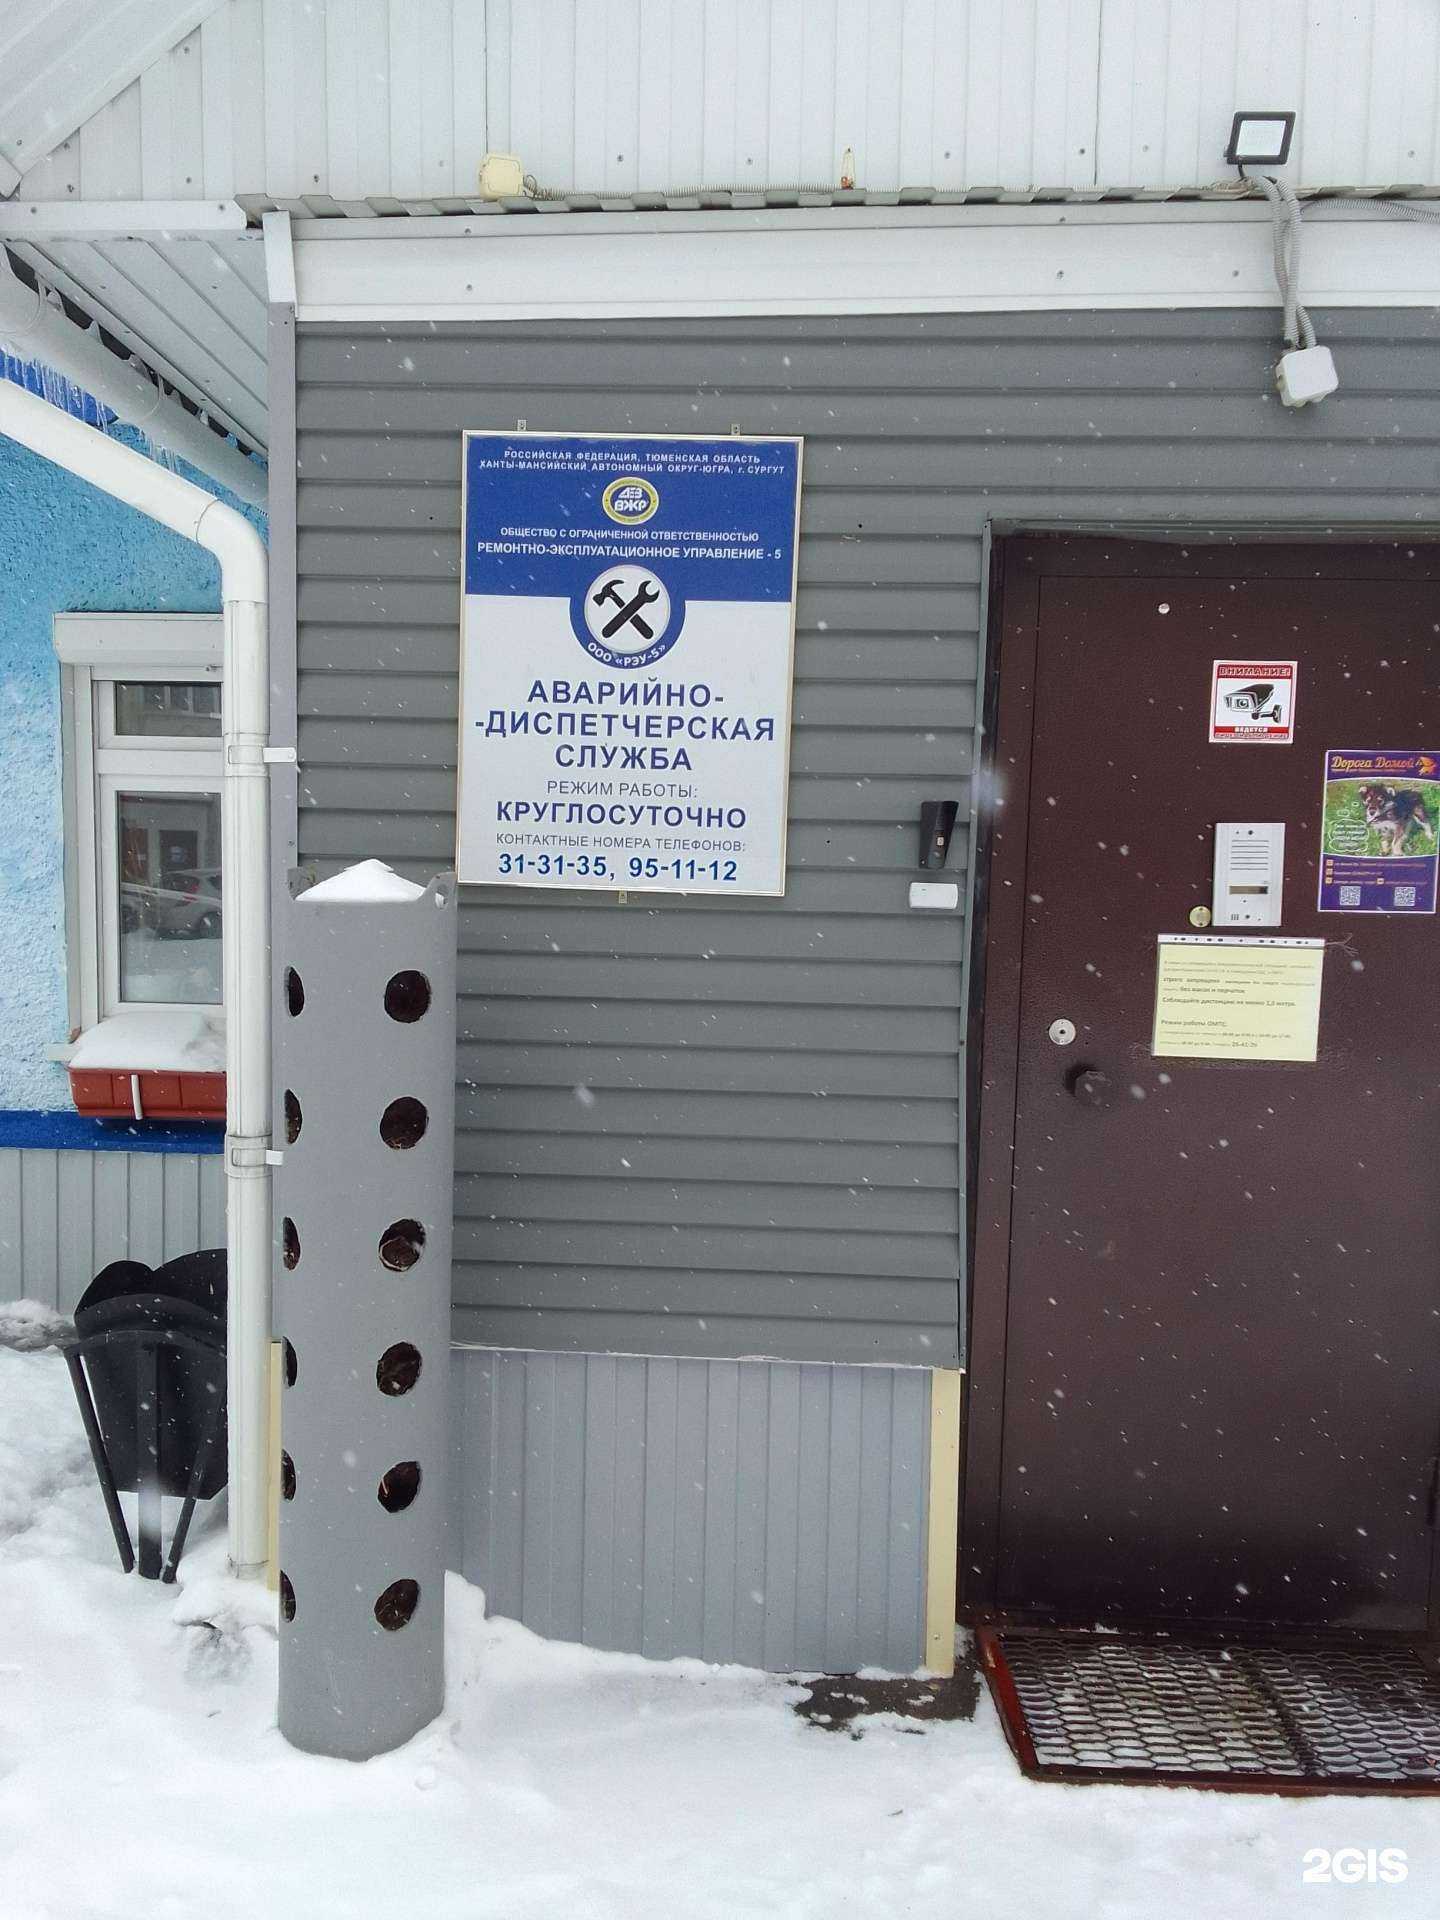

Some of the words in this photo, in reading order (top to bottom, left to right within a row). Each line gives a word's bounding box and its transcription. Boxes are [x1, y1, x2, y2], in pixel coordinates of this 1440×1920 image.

[504, 450, 571, 460] РОССИЙСКАЯ
[577, 451, 640, 463] ФЕДЕРАЦИЯ,
[646, 453, 708, 463] ТЮМЕНСКАЯ
[713, 455, 760, 464] ОБЛАСТЬ
[480, 460, 587, 471] ХАНТЫ-МАНСИЙСКИЙ
[591, 462, 663, 473] АВТОНОМНЫЙ
[668, 464, 733, 475] ОКРУГ-ЮГРА,
[748, 465, 785, 474] СУРГУТ
[614, 499, 647, 512] ВЖР
[500, 527, 557, 539] ОБЩЕСТВО
[559, 529, 567, 539] С
[569, 528, 649, 541] ОГРАНИЧЕННОЙ
[650, 530, 759, 543] ОТВЕТСТВЕННОСТЬЮ
[477, 542, 680, 559] РЕМОНТНО-ЭКСПЛУАТАЦИОННОЕ
[683, 547, 764, 560] УПРАВЛЕНИЕ
[774, 549, 781, 560] 5
[587, 642, 613, 663] ООО
[615, 644, 667, 667] «РЭУ-5»
[527, 677, 724, 708] АВАРИЙНО-
[475, 710, 775, 741] -ДИСПЕТЧЕРСКАЯ
[555, 743, 692, 771] СЛУЖБА
[1331, 756, 1372, 772] Дорога
[547, 780, 613, 796] РЕЖИМ
[619, 783, 697, 798] РАБОТЫ:
[496, 801, 746, 829] КРУГЛОСУТОЧНО
[496, 833, 588, 847] КОНТАКТНЫЕ
[593, 836, 651, 849] НОМЕРА
[655, 838, 746, 852] ТЕЛЕФОНОВ:
[499, 853, 616, 881] 31-31-35,
[629, 857, 738, 882] 95-11-12
